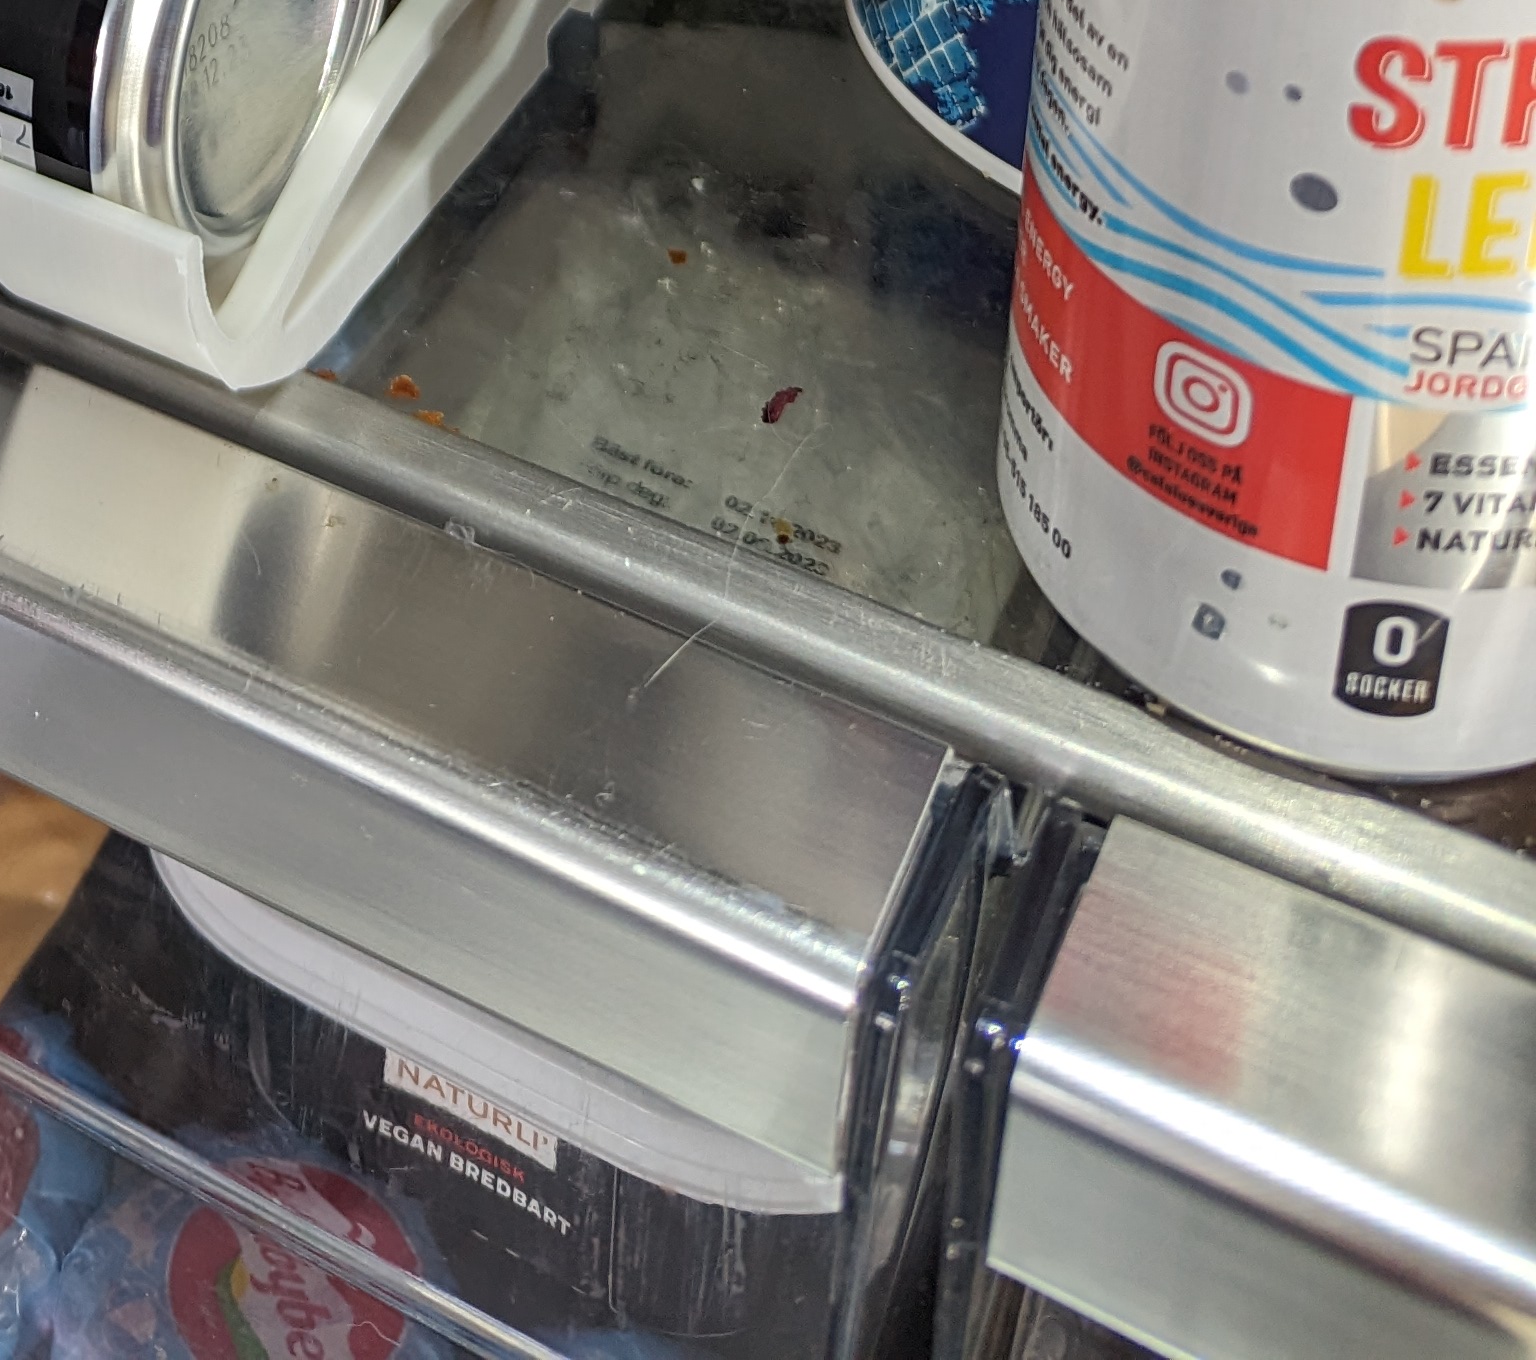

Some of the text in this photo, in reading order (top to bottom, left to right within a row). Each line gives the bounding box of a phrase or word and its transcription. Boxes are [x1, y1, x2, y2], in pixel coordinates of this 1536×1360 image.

[15, 123, 32, 149] 7
[1397, 171, 1536, 281] LE
[1410, 326, 1531, 370] SPA
[1428, 451, 1536, 478] ESSE
[1422, 490, 1536, 517] 7 VITA
[1416, 527, 1536, 552] NATUR
[1373, 614, 1418, 667] 0
[1344, 672, 1432, 704] SOCKER
[414, 1112, 525, 1185] EKOLOGISK
[362, 1109, 571, 1236] VEGAN BREDBART
